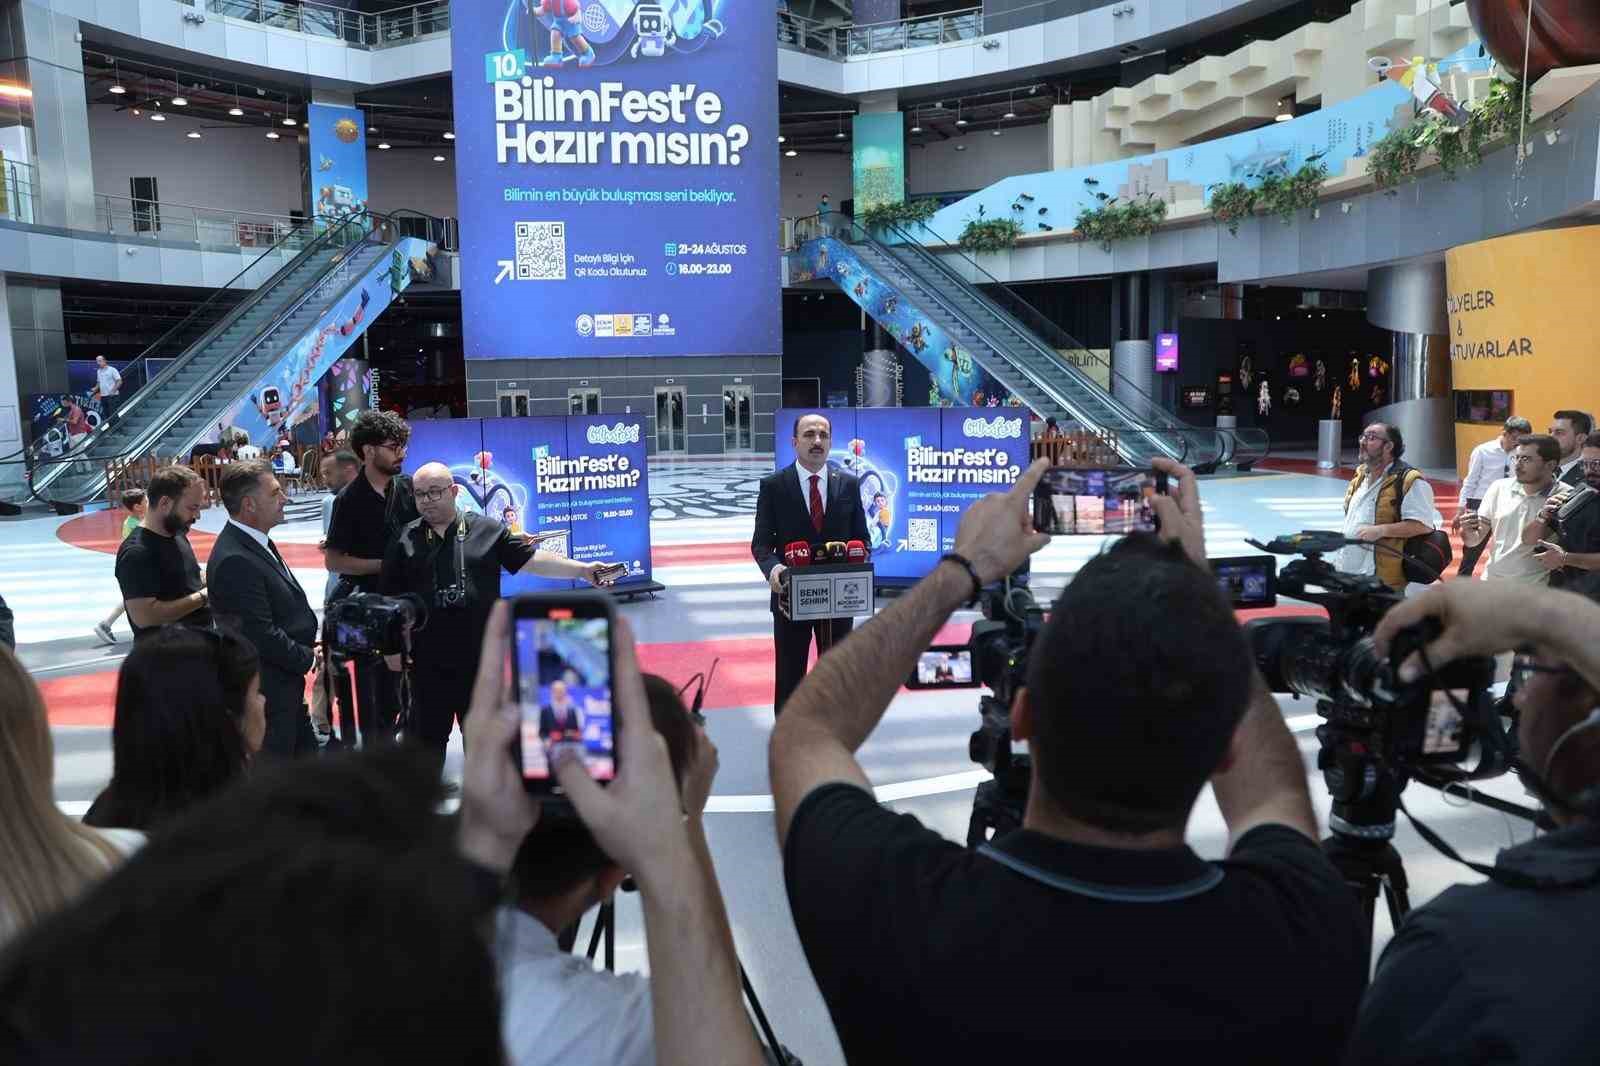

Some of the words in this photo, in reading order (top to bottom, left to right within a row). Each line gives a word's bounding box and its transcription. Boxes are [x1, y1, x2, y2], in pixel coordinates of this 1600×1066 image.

[492, 53, 522, 78] 10.
[494, 75, 722, 124] BilimFest'e
[496, 123, 604, 164] Hazır
[610, 124, 749, 166] mısın?
[504, 188, 543, 201] Bilimin
[545, 192, 560, 201] en
[562, 188, 600, 205] büyük
[601, 188, 662, 205] buluşması
[664, 188, 688, 201] seni
[690, 188, 736, 205] bekliyor.
[704, 242, 747, 255] AĞUSTOS
[574, 253, 601, 265] Detaylı
[603, 253, 619, 265] Bilgi
[574, 267, 586, 278] QR
[587, 267, 608, 277] Kodu
[610, 267, 648, 277] Okutunuz
[537, 475, 582, 494] Hazır
[584, 469, 640, 490] mısın?
[908, 465, 956, 483] Hazır
[958, 465, 1020, 484] mısın?
